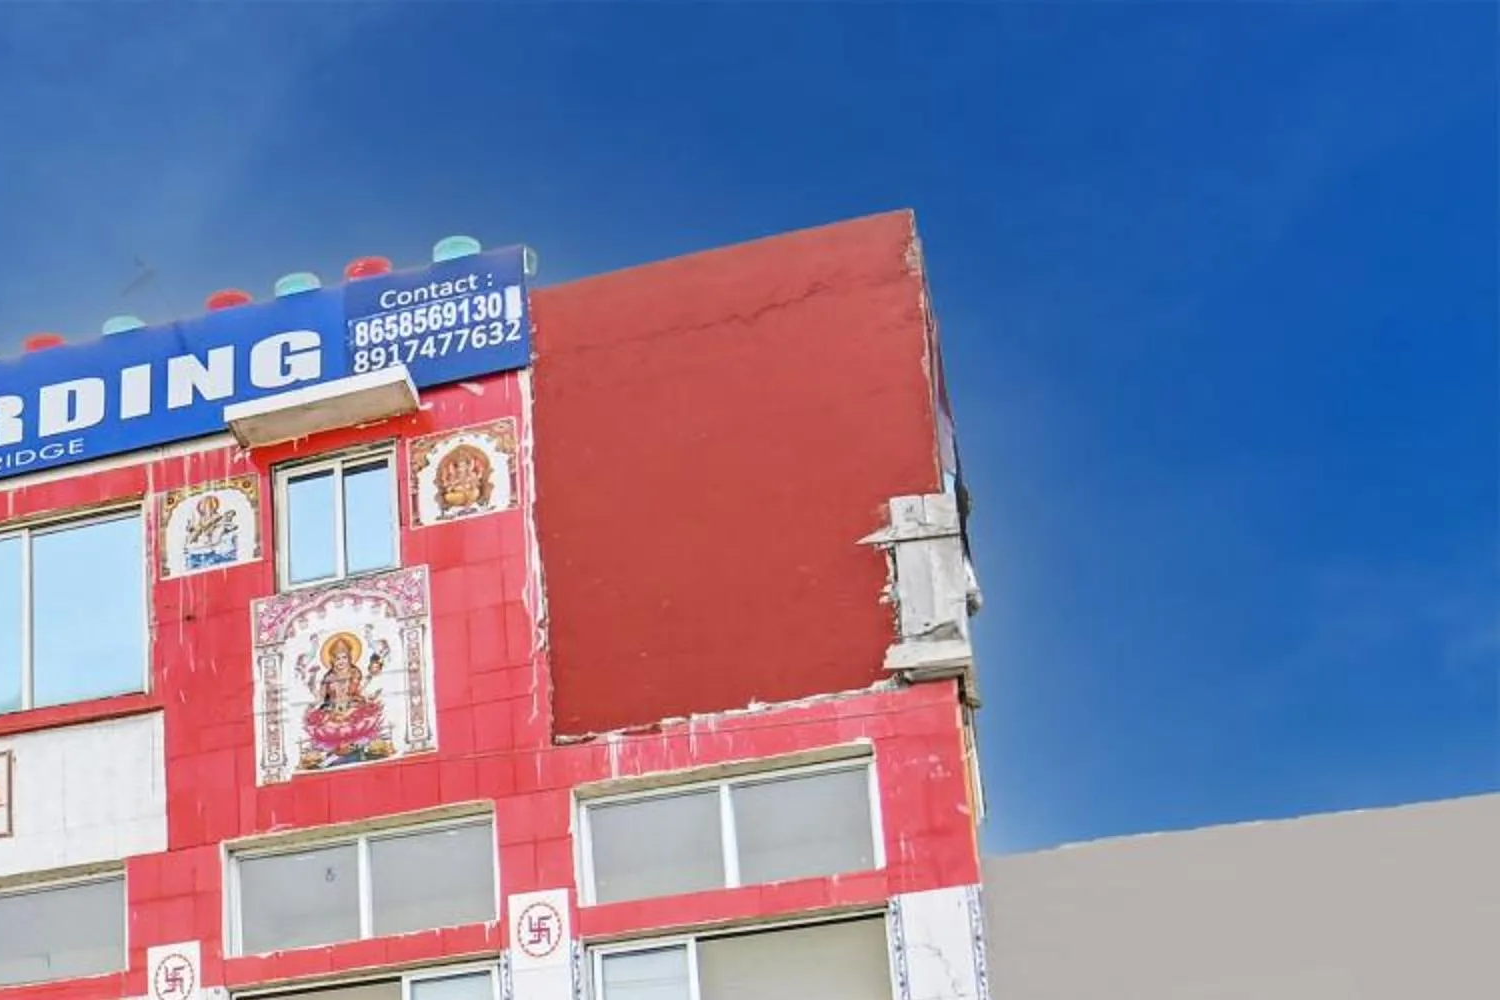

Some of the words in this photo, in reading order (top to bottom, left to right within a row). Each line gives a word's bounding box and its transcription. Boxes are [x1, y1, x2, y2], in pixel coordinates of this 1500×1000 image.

[380, 272, 478, 309] Contact
[353, 318, 522, 374] 8917477632
[354, 291, 503, 348] 8658569130
